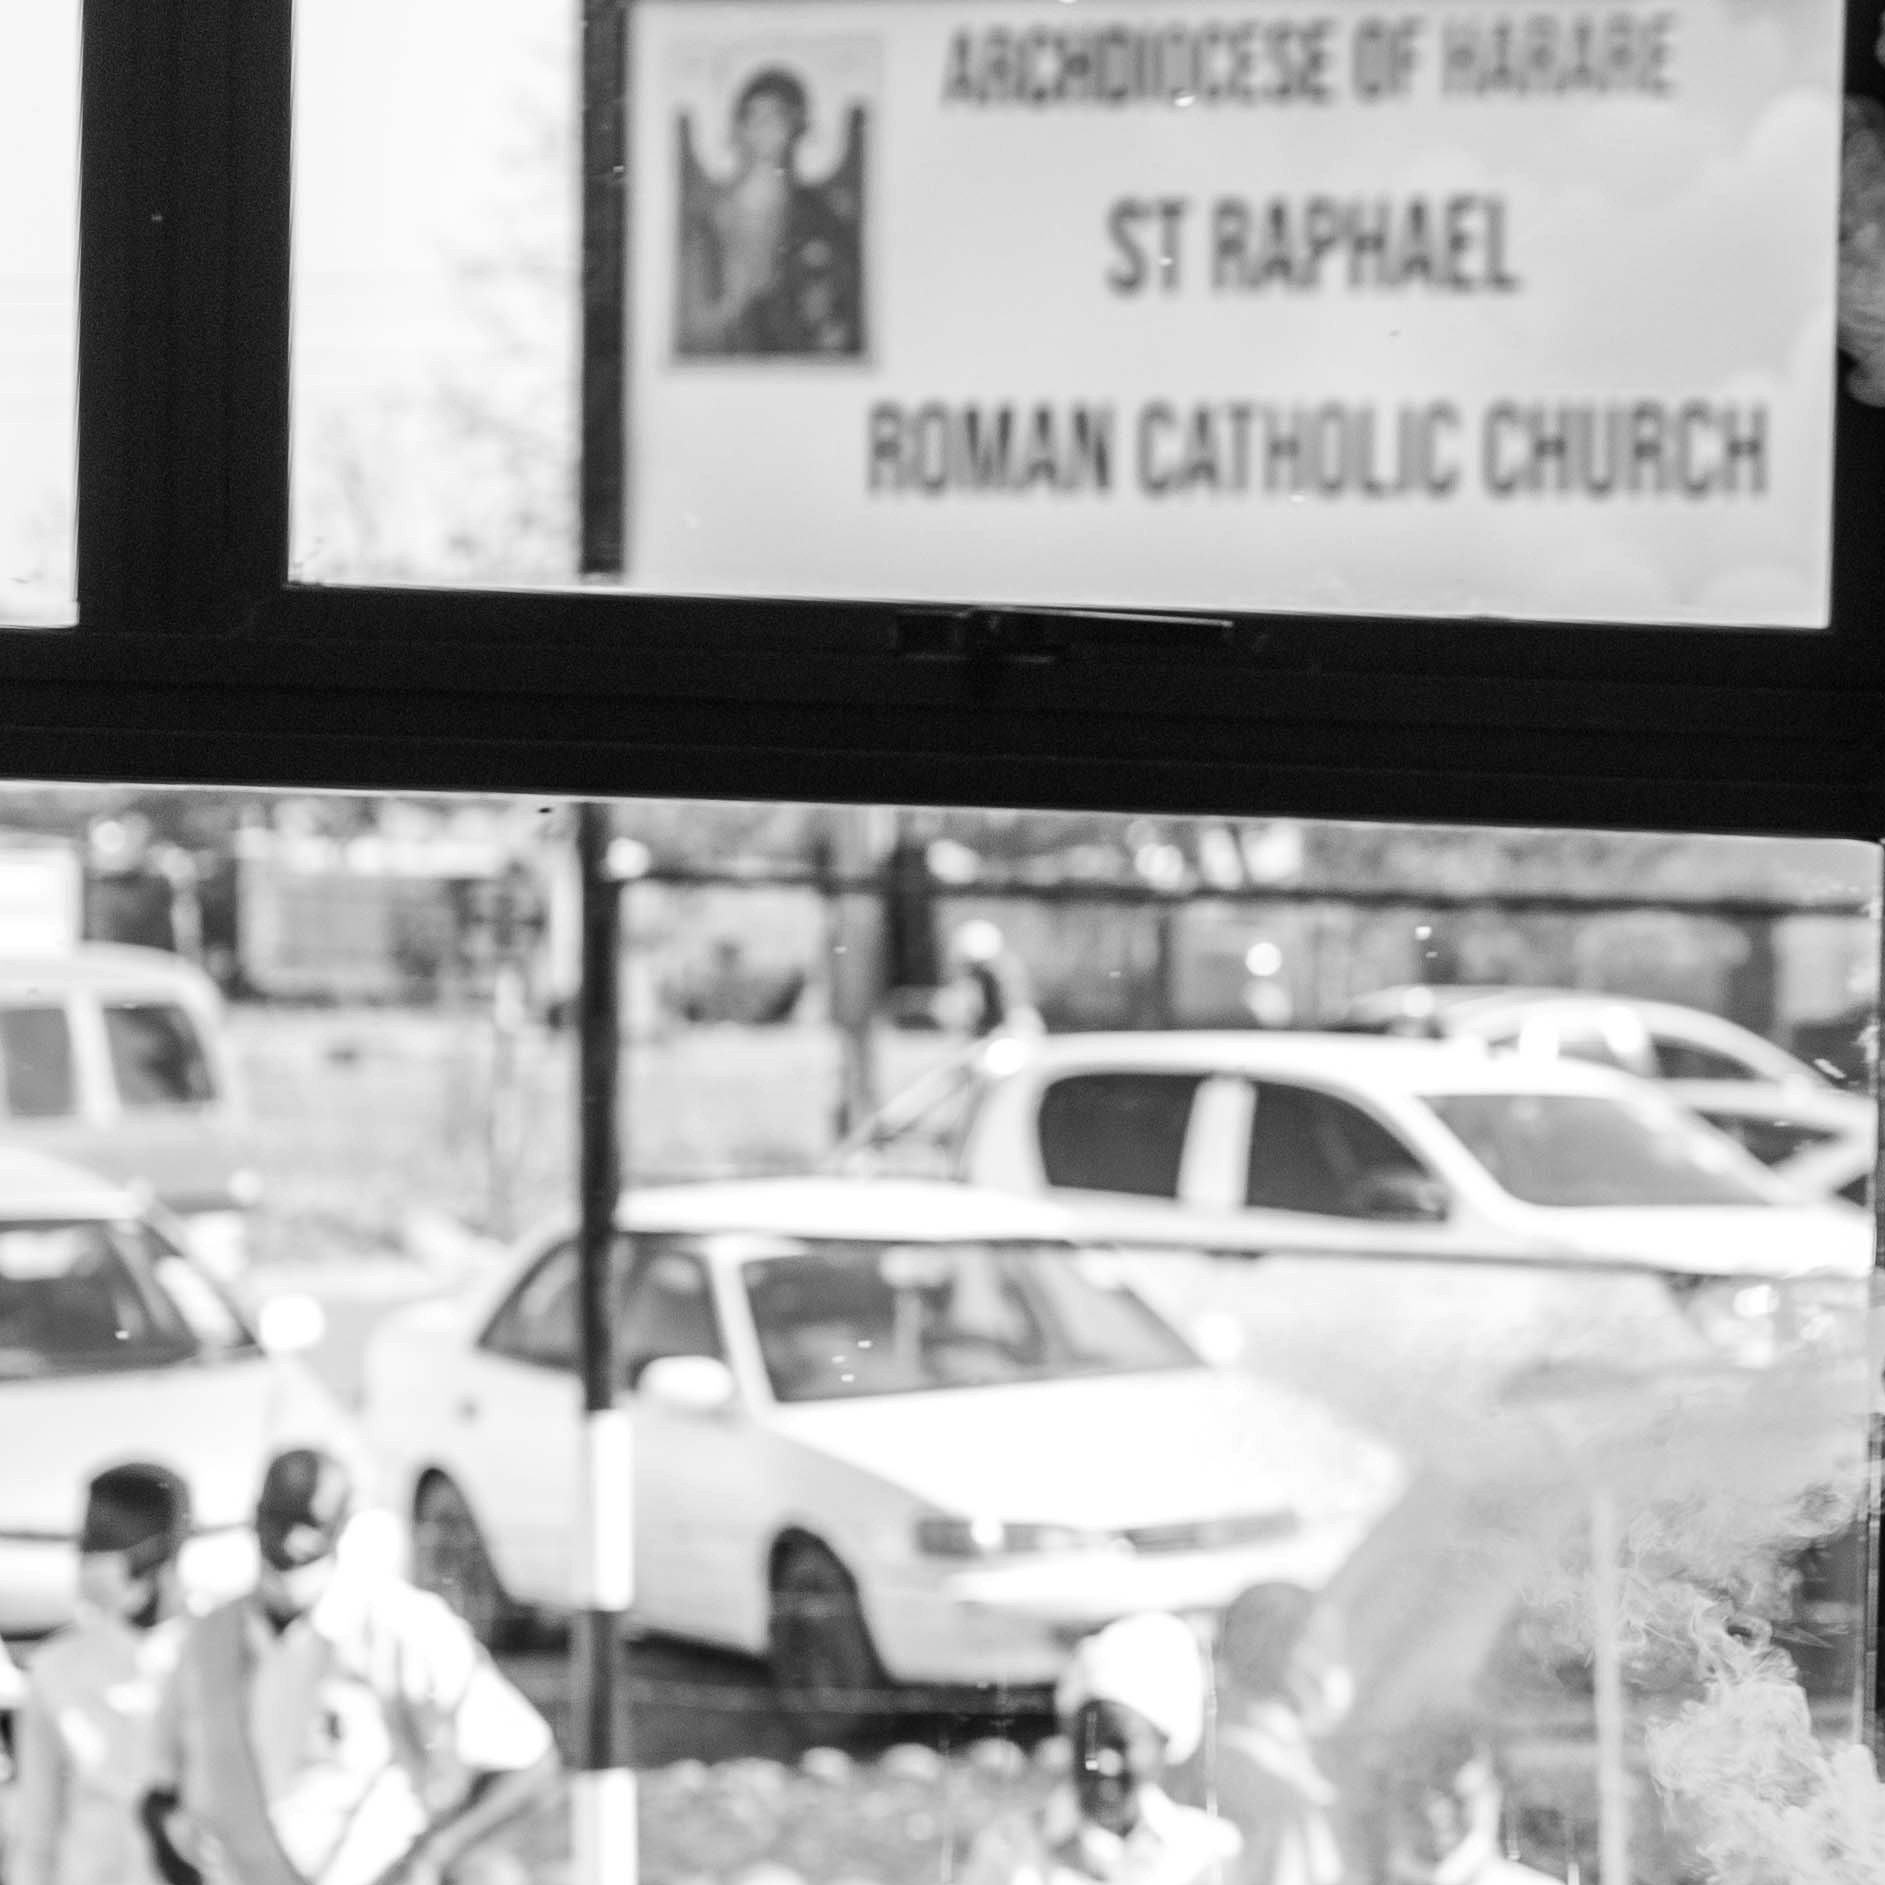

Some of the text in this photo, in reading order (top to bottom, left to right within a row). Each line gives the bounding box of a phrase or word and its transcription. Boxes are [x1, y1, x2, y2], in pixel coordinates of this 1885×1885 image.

[942, 10, 1676, 106] ARCHDIOCESE OF HARARE
[1107, 194, 1521, 295] ST RAPHAEL
[867, 400, 1767, 497] ROMAN CATHOLIC CHURCH
